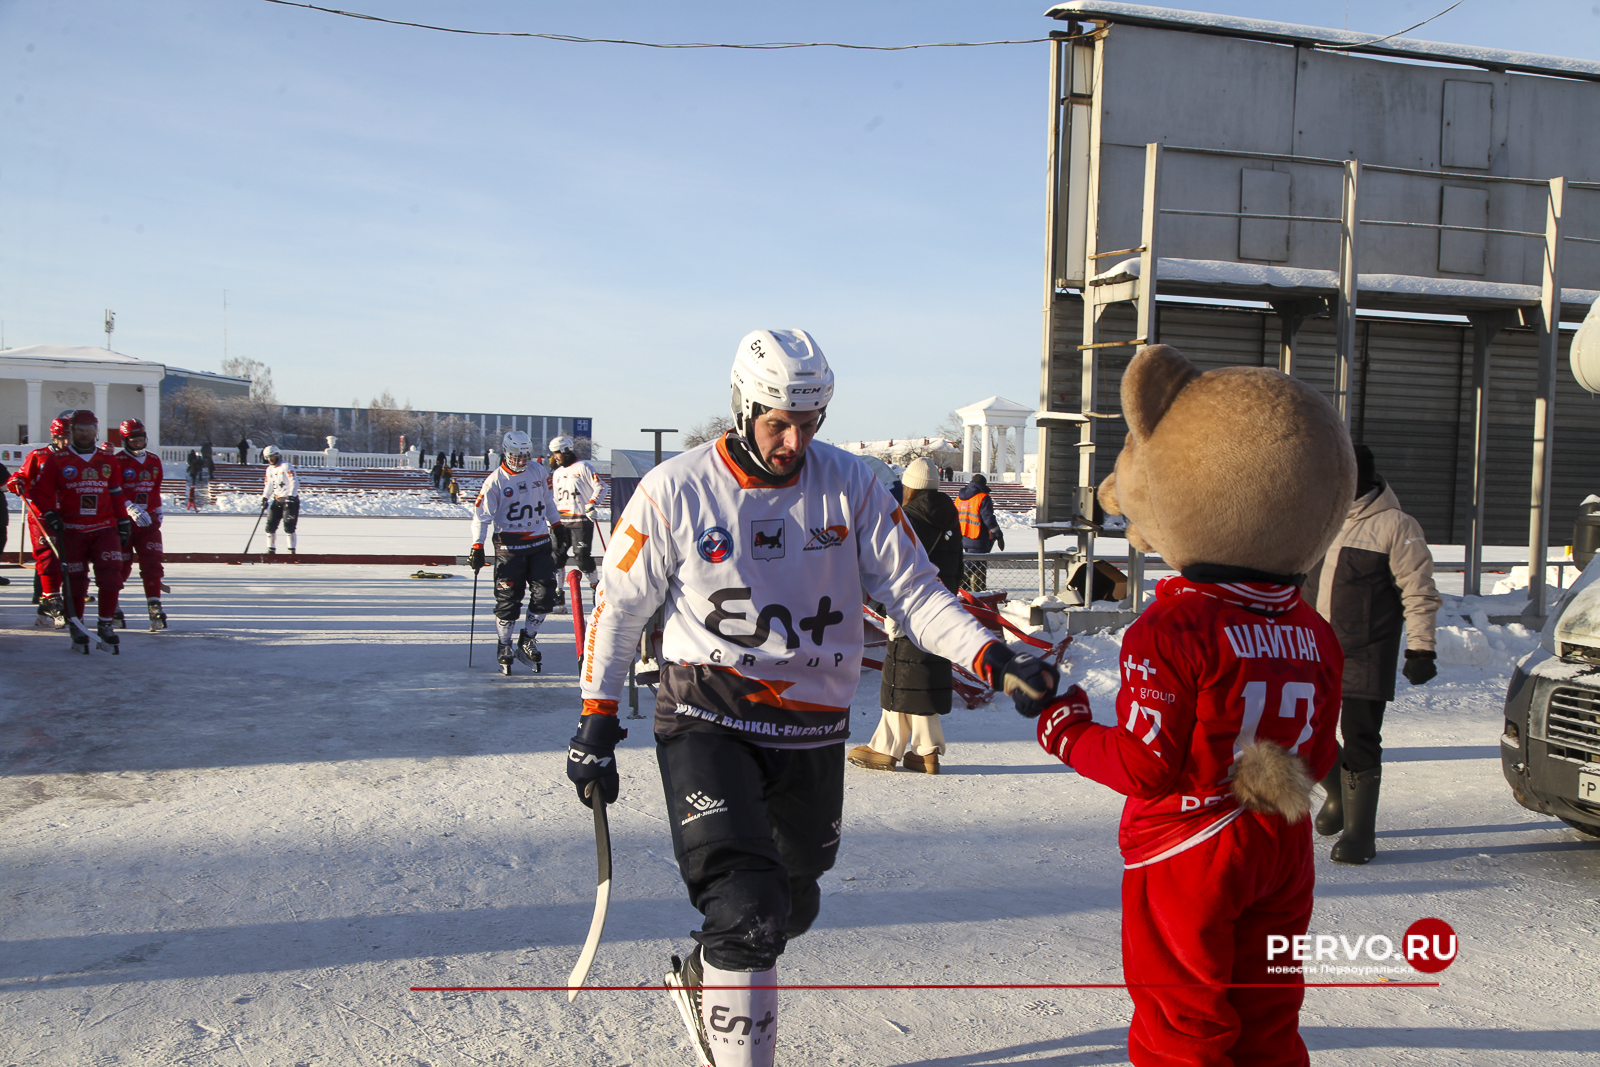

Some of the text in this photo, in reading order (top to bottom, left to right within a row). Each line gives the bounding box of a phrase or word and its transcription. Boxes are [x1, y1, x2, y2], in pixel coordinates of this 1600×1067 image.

[791, 386, 822, 395] CCM
[1224, 617, 1321, 663] ШАЙТАН
[709, 648, 844, 668] GROUP
[1139, 687, 1176, 703] group
[568, 744, 613, 768] CM
